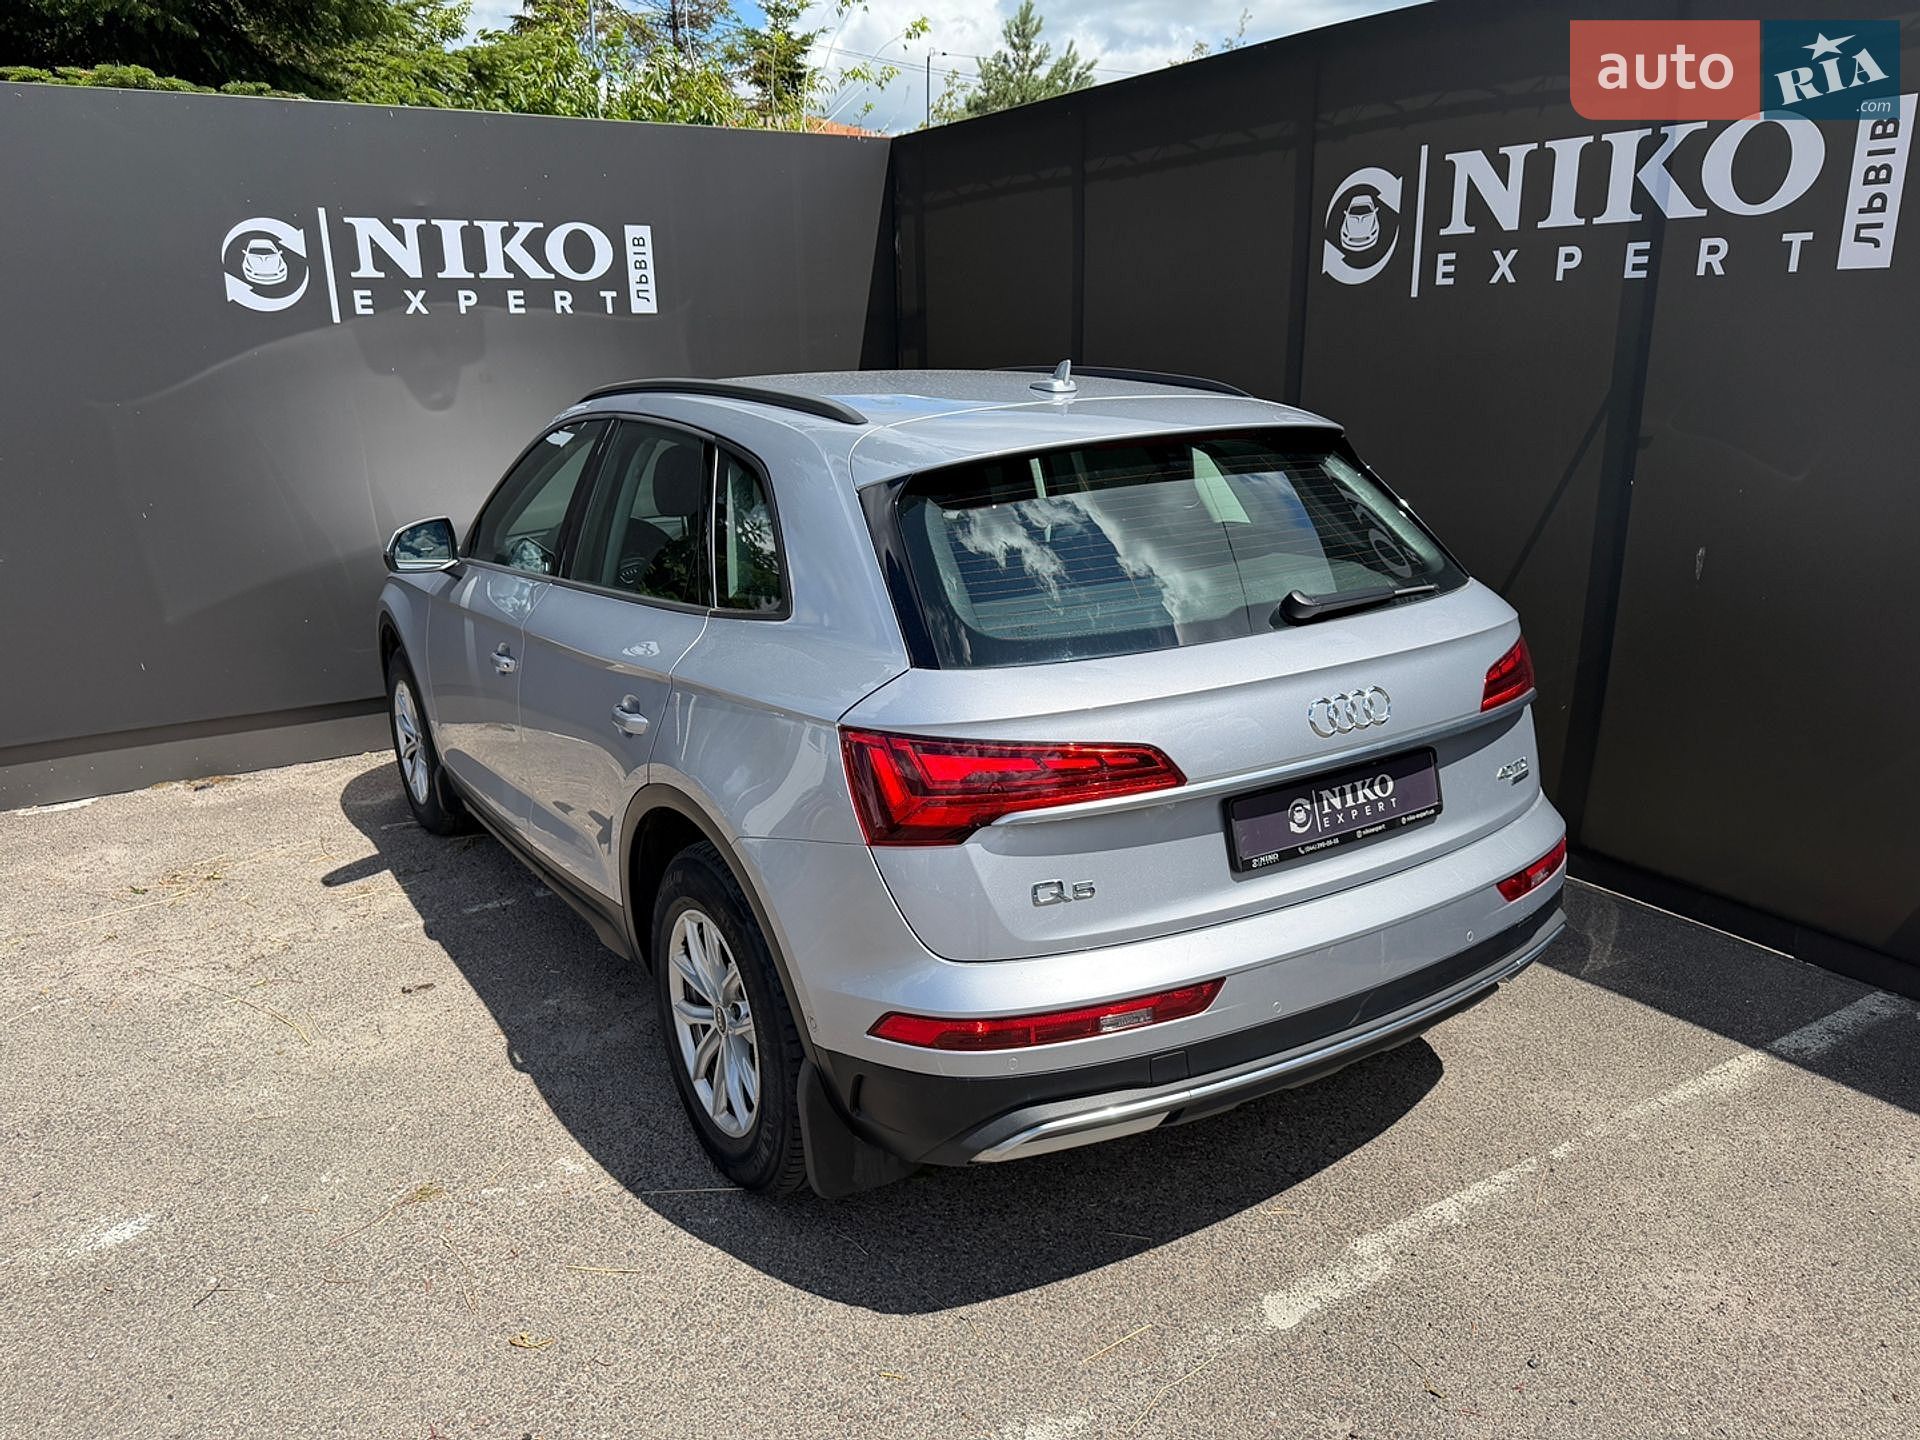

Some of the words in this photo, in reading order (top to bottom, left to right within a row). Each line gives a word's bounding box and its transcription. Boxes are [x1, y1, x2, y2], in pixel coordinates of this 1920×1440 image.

[1439, 110, 1825, 237] NIKO
[343, 217, 614, 281] NIKO
[632, 236, 650, 302] ЛЬВІВ
[1435, 231, 1814, 286] EXPERT
[353, 290, 617, 315] EXPERT
[1319, 774, 1394, 814] NIKO
[1322, 797, 1397, 828] EXPERT
[1030, 879, 1096, 907] Q5
